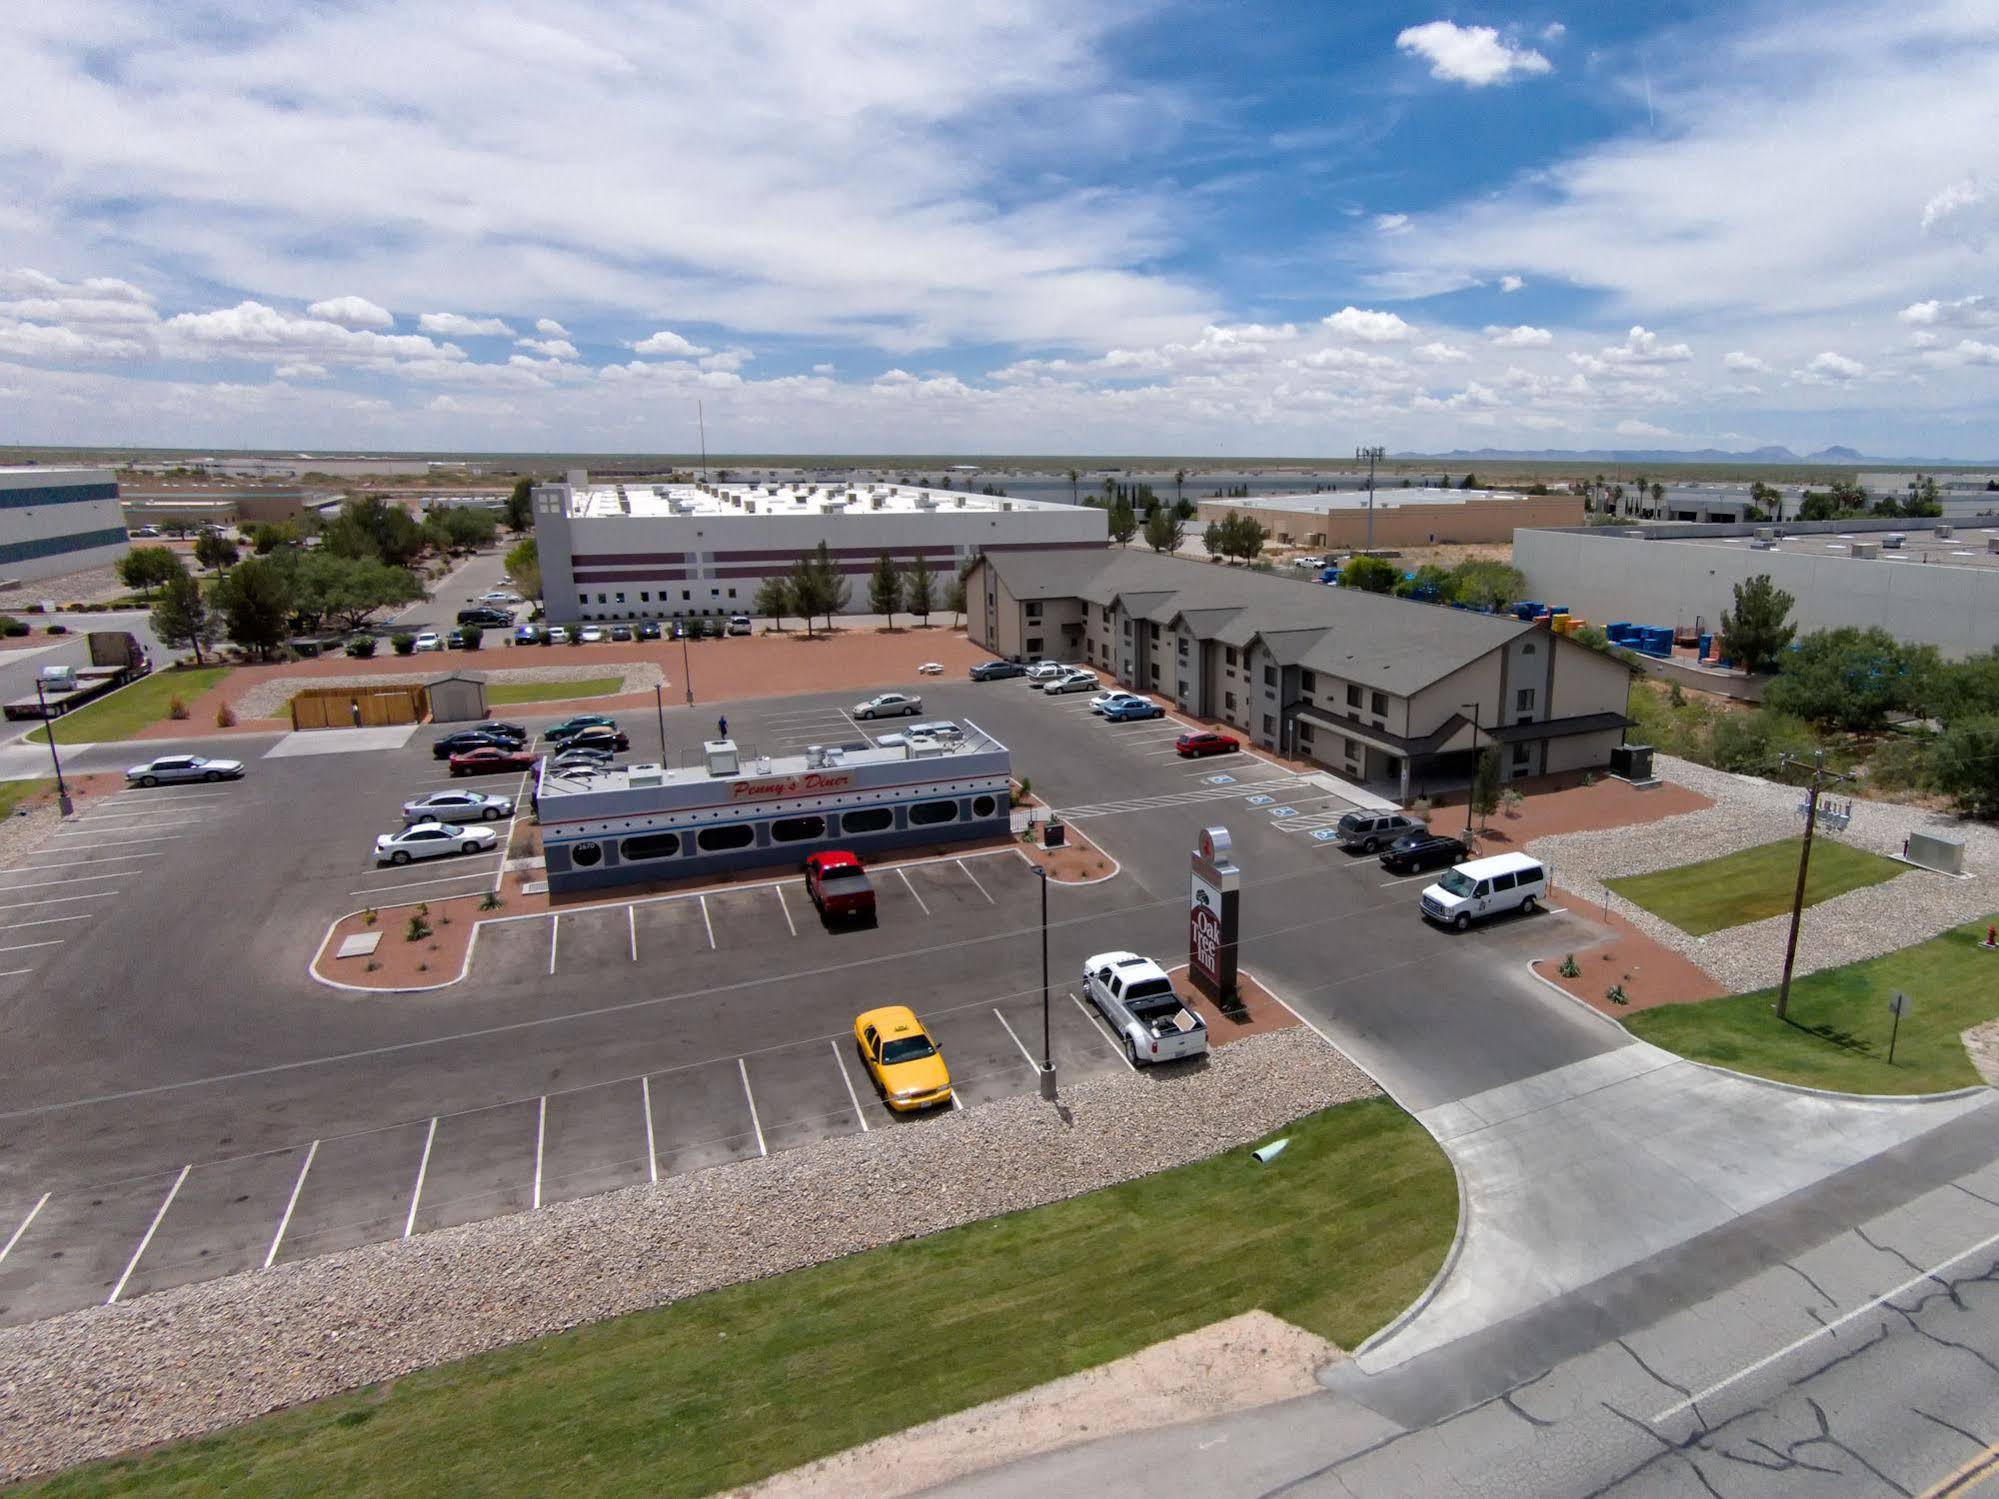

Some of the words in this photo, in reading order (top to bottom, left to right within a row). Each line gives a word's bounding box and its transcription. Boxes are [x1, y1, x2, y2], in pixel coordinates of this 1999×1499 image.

[733, 778, 797, 797] Penny's
[804, 773, 848, 789] Diner
[1191, 920, 1216, 957] Tree
[1198, 911, 1220, 945] Oak
[1198, 944, 1215, 973] Inn
